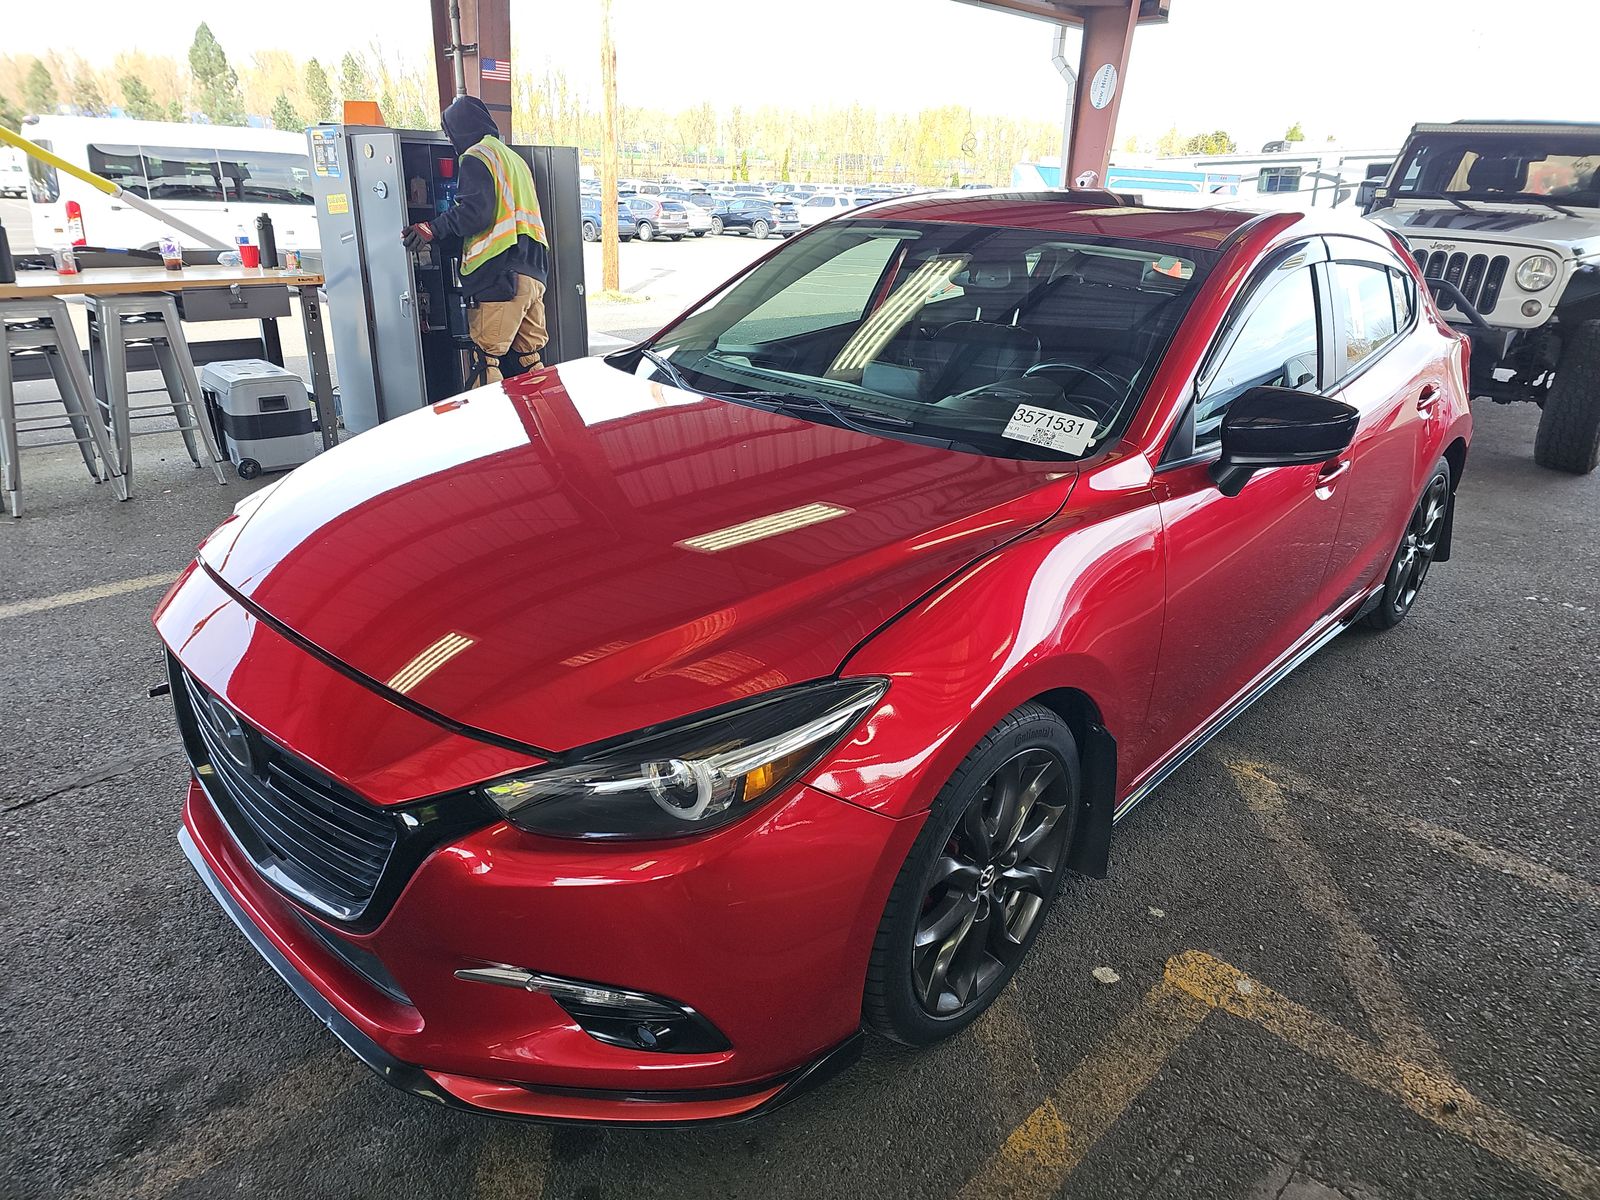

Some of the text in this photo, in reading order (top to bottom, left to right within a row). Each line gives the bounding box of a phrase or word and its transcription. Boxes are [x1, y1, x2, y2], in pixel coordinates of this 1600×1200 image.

[1096, 91, 1104, 108] Now
[1100, 64, 1112, 89] Hiring
[1430, 241, 1456, 251] Jeep
[1013, 408, 1085, 436] 3571531
